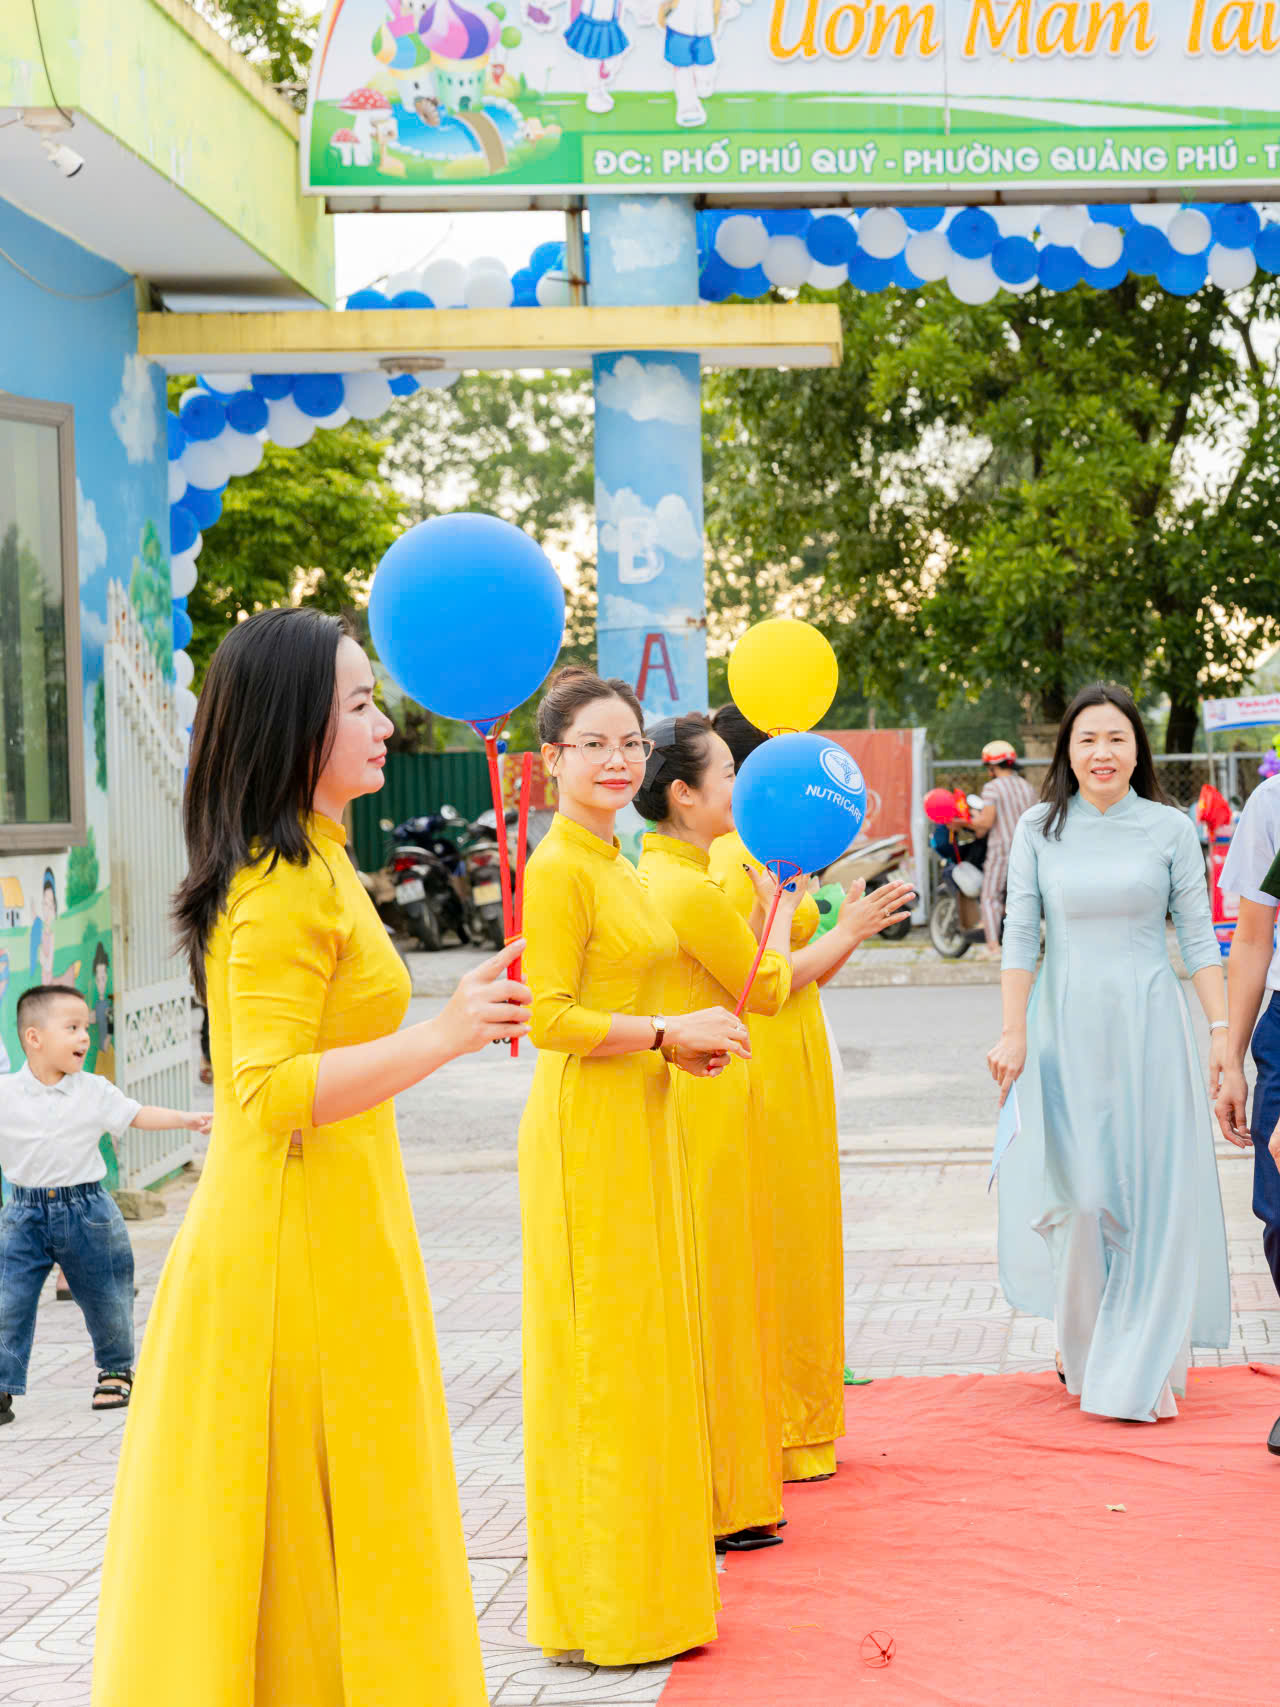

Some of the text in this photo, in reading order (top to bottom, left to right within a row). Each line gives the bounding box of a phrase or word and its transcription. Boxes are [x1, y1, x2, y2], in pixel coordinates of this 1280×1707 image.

[593, 149, 653, 176] ĐC:
[661, 137, 731, 176] PHỐ
[738, 140, 802, 175] PHÚ
[809, 141, 878, 175] QUÝ
[903, 141, 1041, 175] PHƯỜNG
[1049, 137, 1169, 173] QUẢNG
[1176, 138, 1238, 172] PHÚ
[618, 516, 664, 584] B
[636, 633, 679, 701] A
